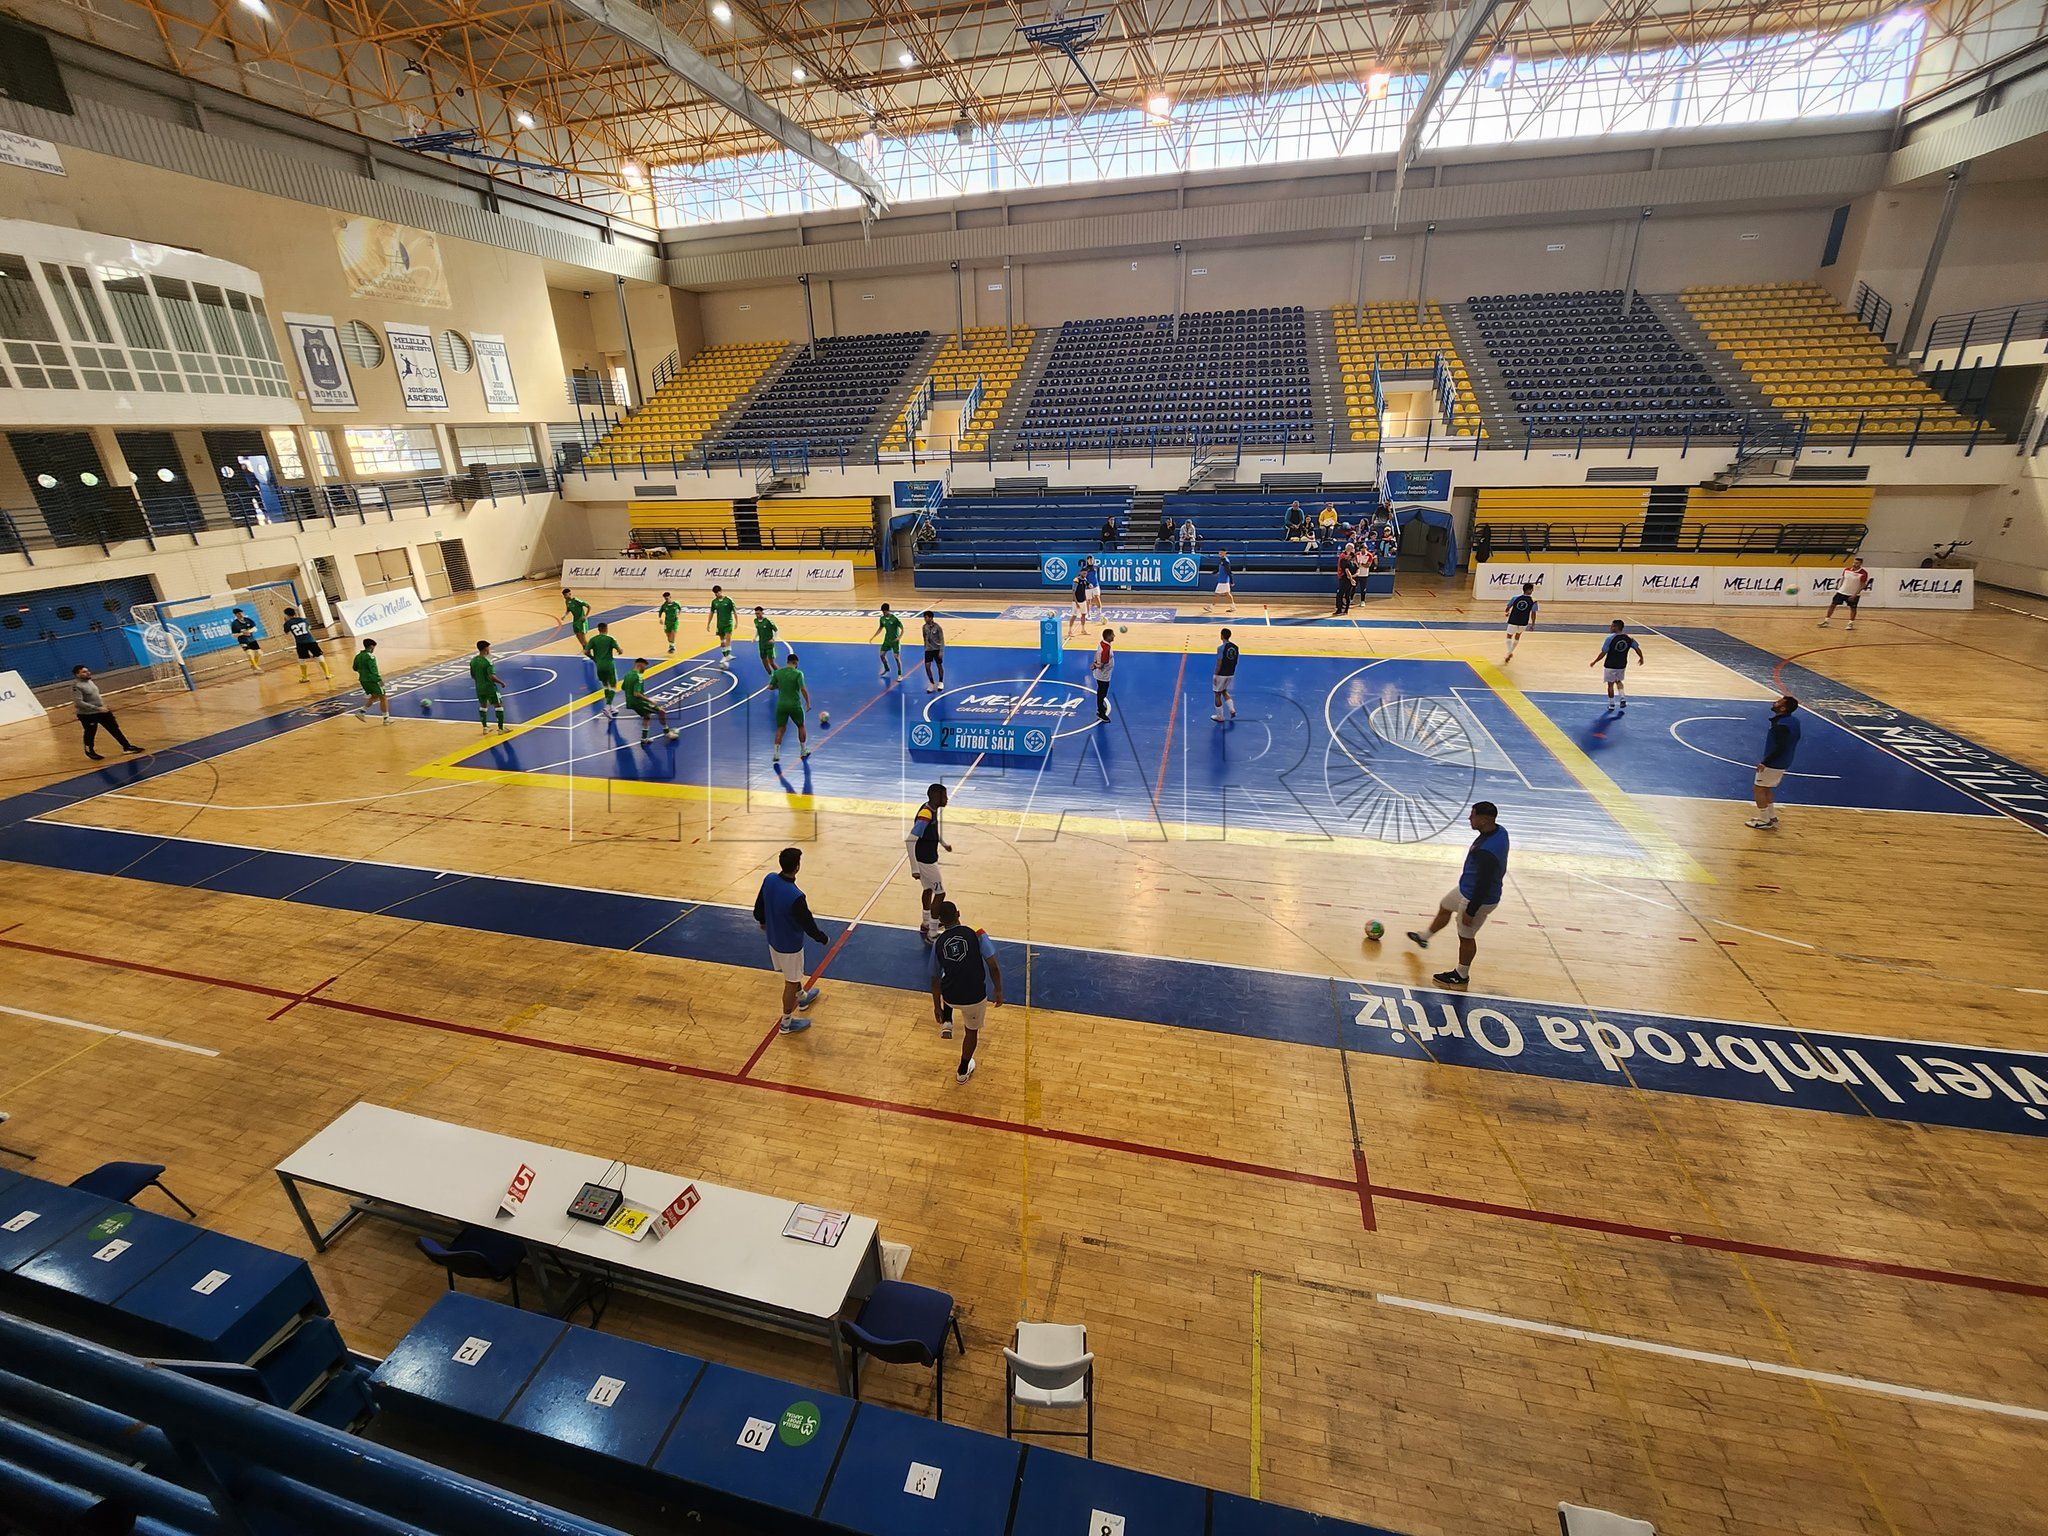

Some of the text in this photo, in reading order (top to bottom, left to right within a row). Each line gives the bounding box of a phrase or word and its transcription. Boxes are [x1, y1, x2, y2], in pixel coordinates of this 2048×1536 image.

[393, 336, 428, 346] MELILLA
[393, 344, 431, 352] BALONCESTO
[477, 343, 503, 351] MELILLA
[312, 348, 330, 366] 14
[415, 367, 437, 379] ACB
[314, 390, 349, 398] ROMERO
[407, 394, 444, 402] ASCENSO
[569, 566, 601, 577] MELILLA
[613, 566, 648, 577] MELILLA
[657, 567, 693, 578] MELILLA
[705, 567, 741, 578] MELILLA
[756, 567, 793, 578] MELILLA
[806, 568, 845, 579] MELILLA
[1099, 564, 1161, 582] ÚTBOL SALA
[1489, 572, 1545, 586] MELILLA
[1566, 574, 1623, 588] MELILLA
[1642, 575, 1700, 589] MELILLA
[1723, 577, 1784, 591] MELILLA
[1899, 579, 1963, 594] MELILLA
[356, 613, 379, 627] VEN
[383, 596, 412, 617] Melilla
[290, 622, 308, 636] 27
[649, 676, 711, 703] ELILLA
[960, 694, 1084, 709] MELILLA
[956, 727, 1015, 736] DIVISIÓN
[955, 733, 1015, 751] FÚTBOL SALA
[1908, 725, 1989, 760] CIUDAD
[1350, 985, 1525, 1057] Ortiz
[1535, 1015, 1906, 1104] Imbroda
[514, 1167, 535, 1191] 5
[673, 1190, 699, 1216] 5
[459, 1346, 479, 1362] 12
[593, 1387, 612, 1403] 11
[744, 1429, 763, 1446] 10
